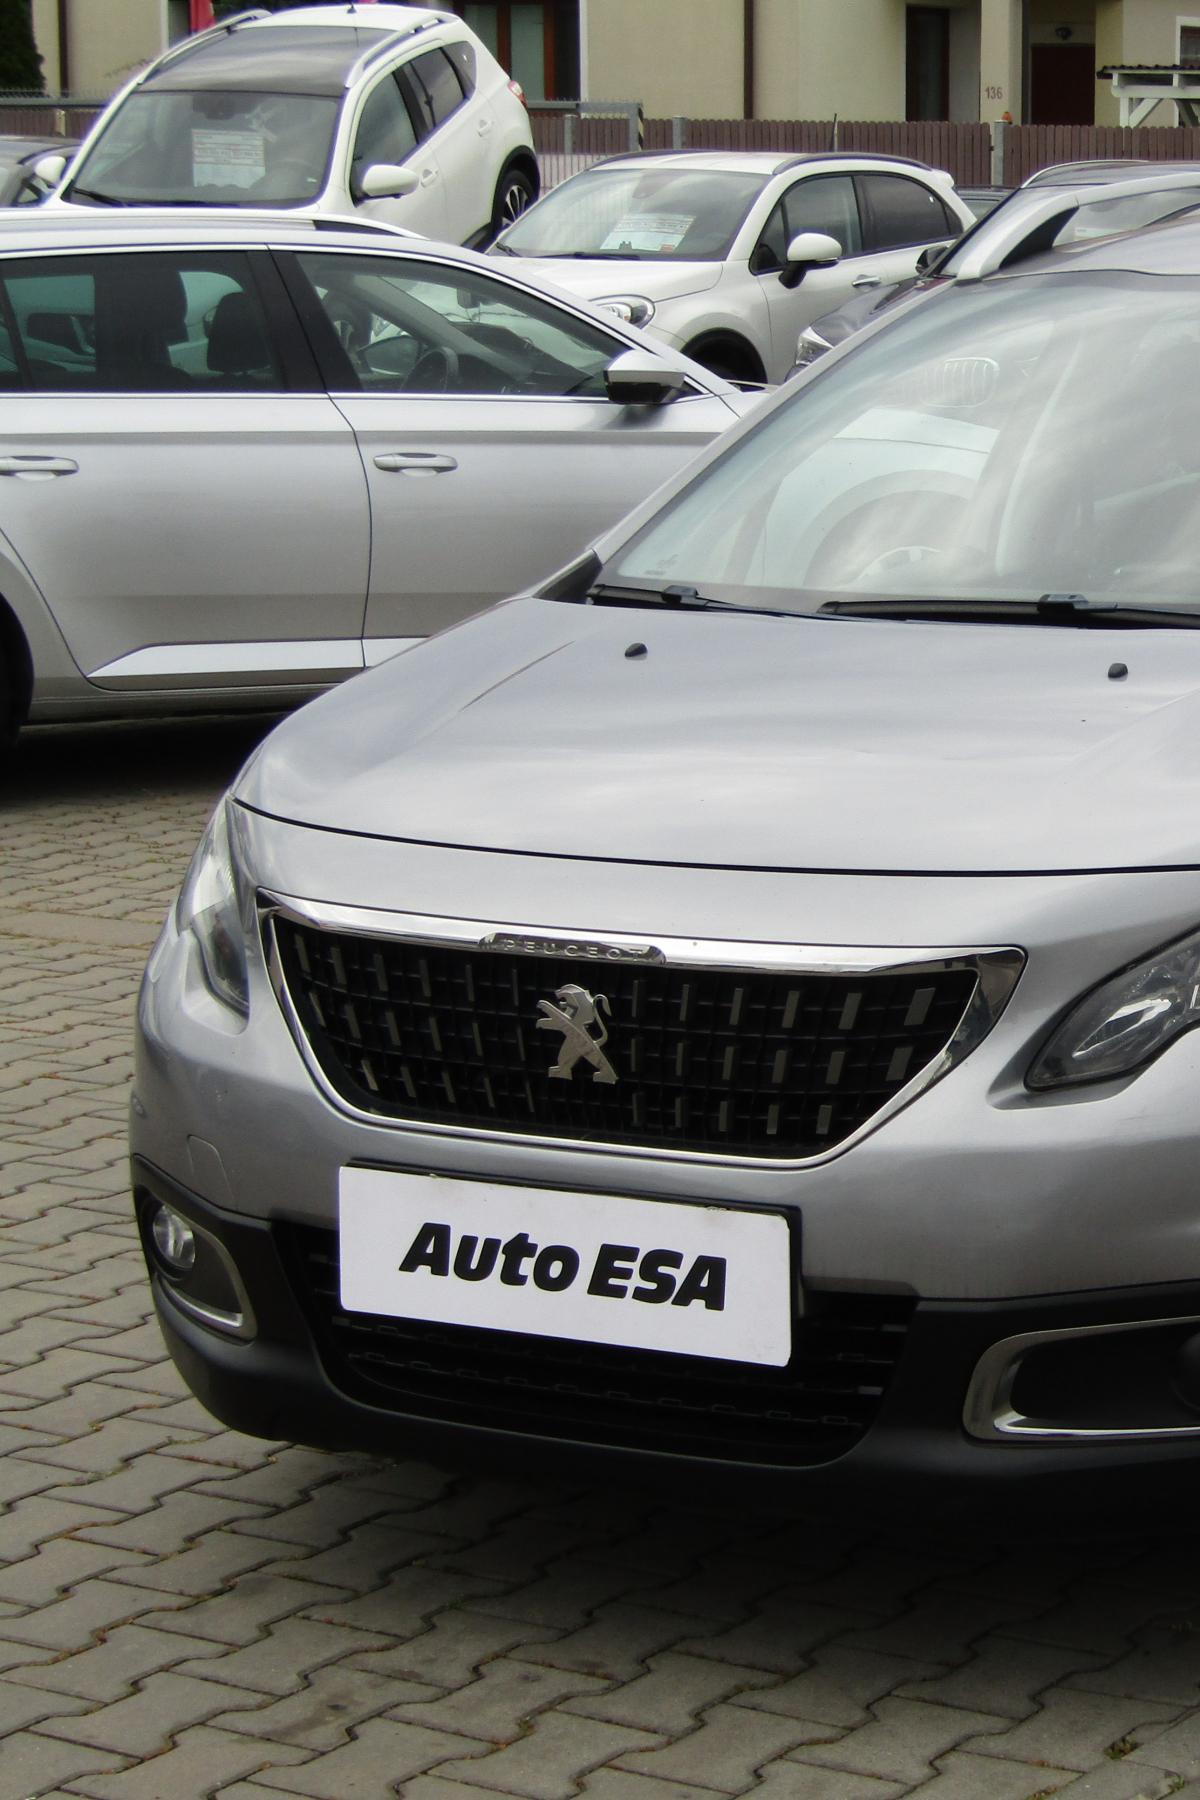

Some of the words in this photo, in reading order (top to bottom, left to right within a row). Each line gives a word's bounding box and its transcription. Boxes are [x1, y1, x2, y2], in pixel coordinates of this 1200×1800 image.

[985, 86, 1003, 100] 136
[503, 939, 643, 961] PEUGEOT
[399, 1222, 580, 1292] Auto
[587, 1243, 727, 1311] ESA
